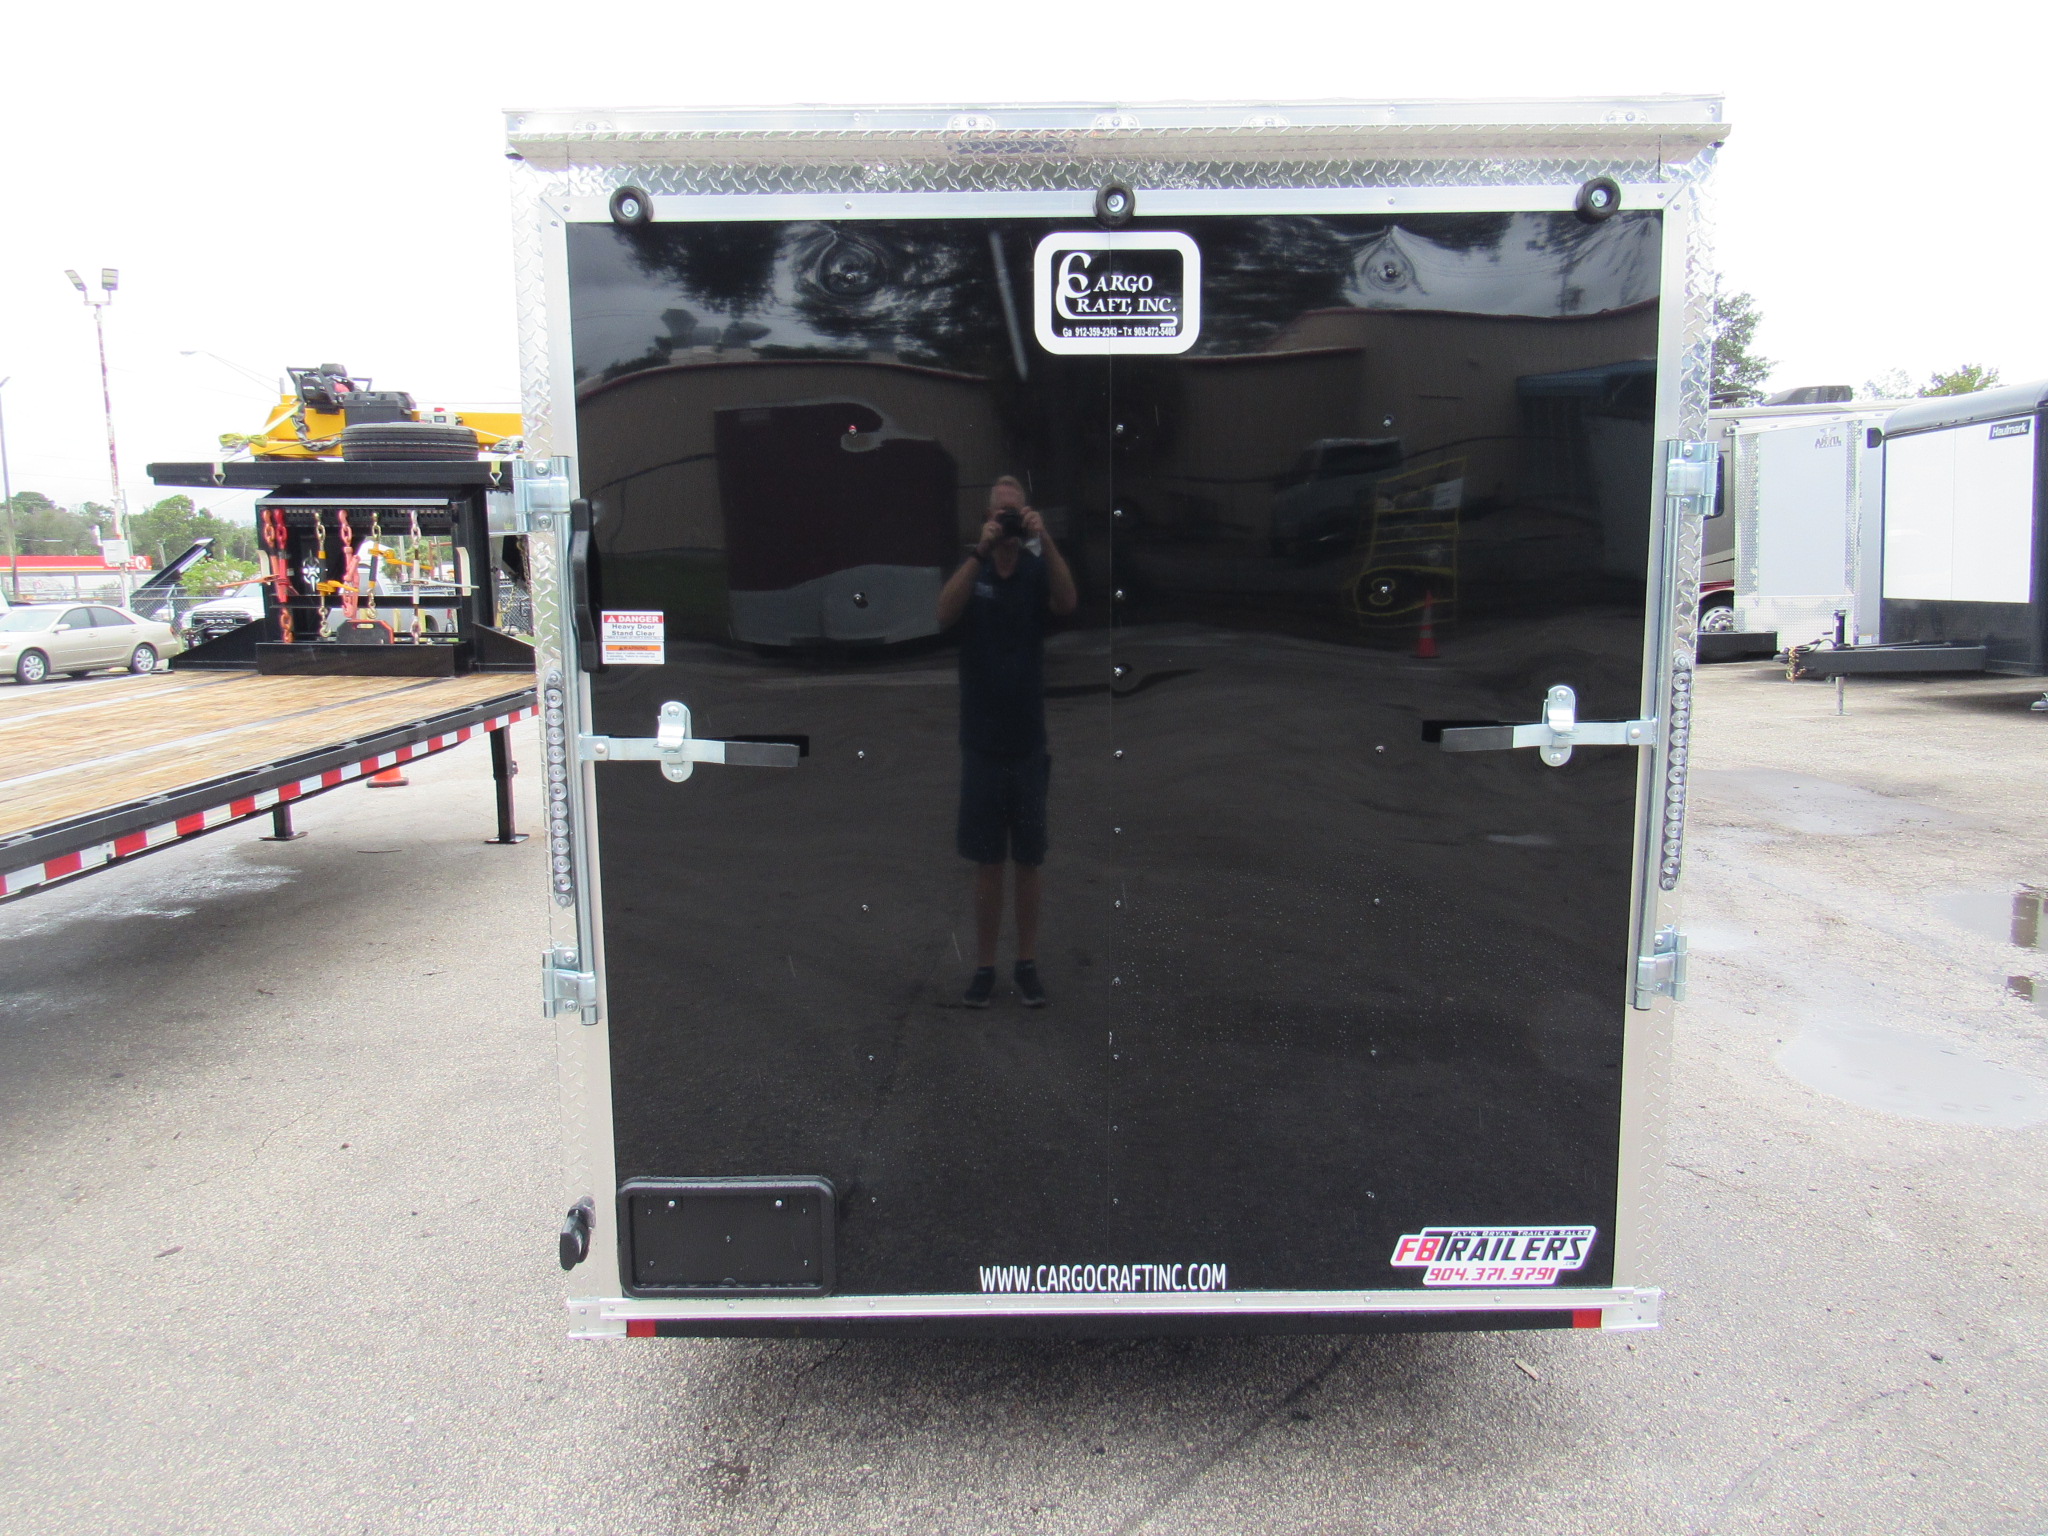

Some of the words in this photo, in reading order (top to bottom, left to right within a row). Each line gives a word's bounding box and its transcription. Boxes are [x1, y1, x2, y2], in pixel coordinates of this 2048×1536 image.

[1059, 252, 1153, 298] CARGO
[1137, 298, 1176, 312] INC.
[1062, 327, 1072, 338] Ga
[1075, 327, 1117, 337] 912-359-2343
[1123, 327, 1132, 336] Tx
[1133, 327, 1176, 337] 903-872-5400
[618, 615, 659, 623] DANGER
[979, 1264, 1227, 1292] WWW.CARGOCRAFTINC.COM
[1427, 1267, 1556, 1281] 904.371.9791
